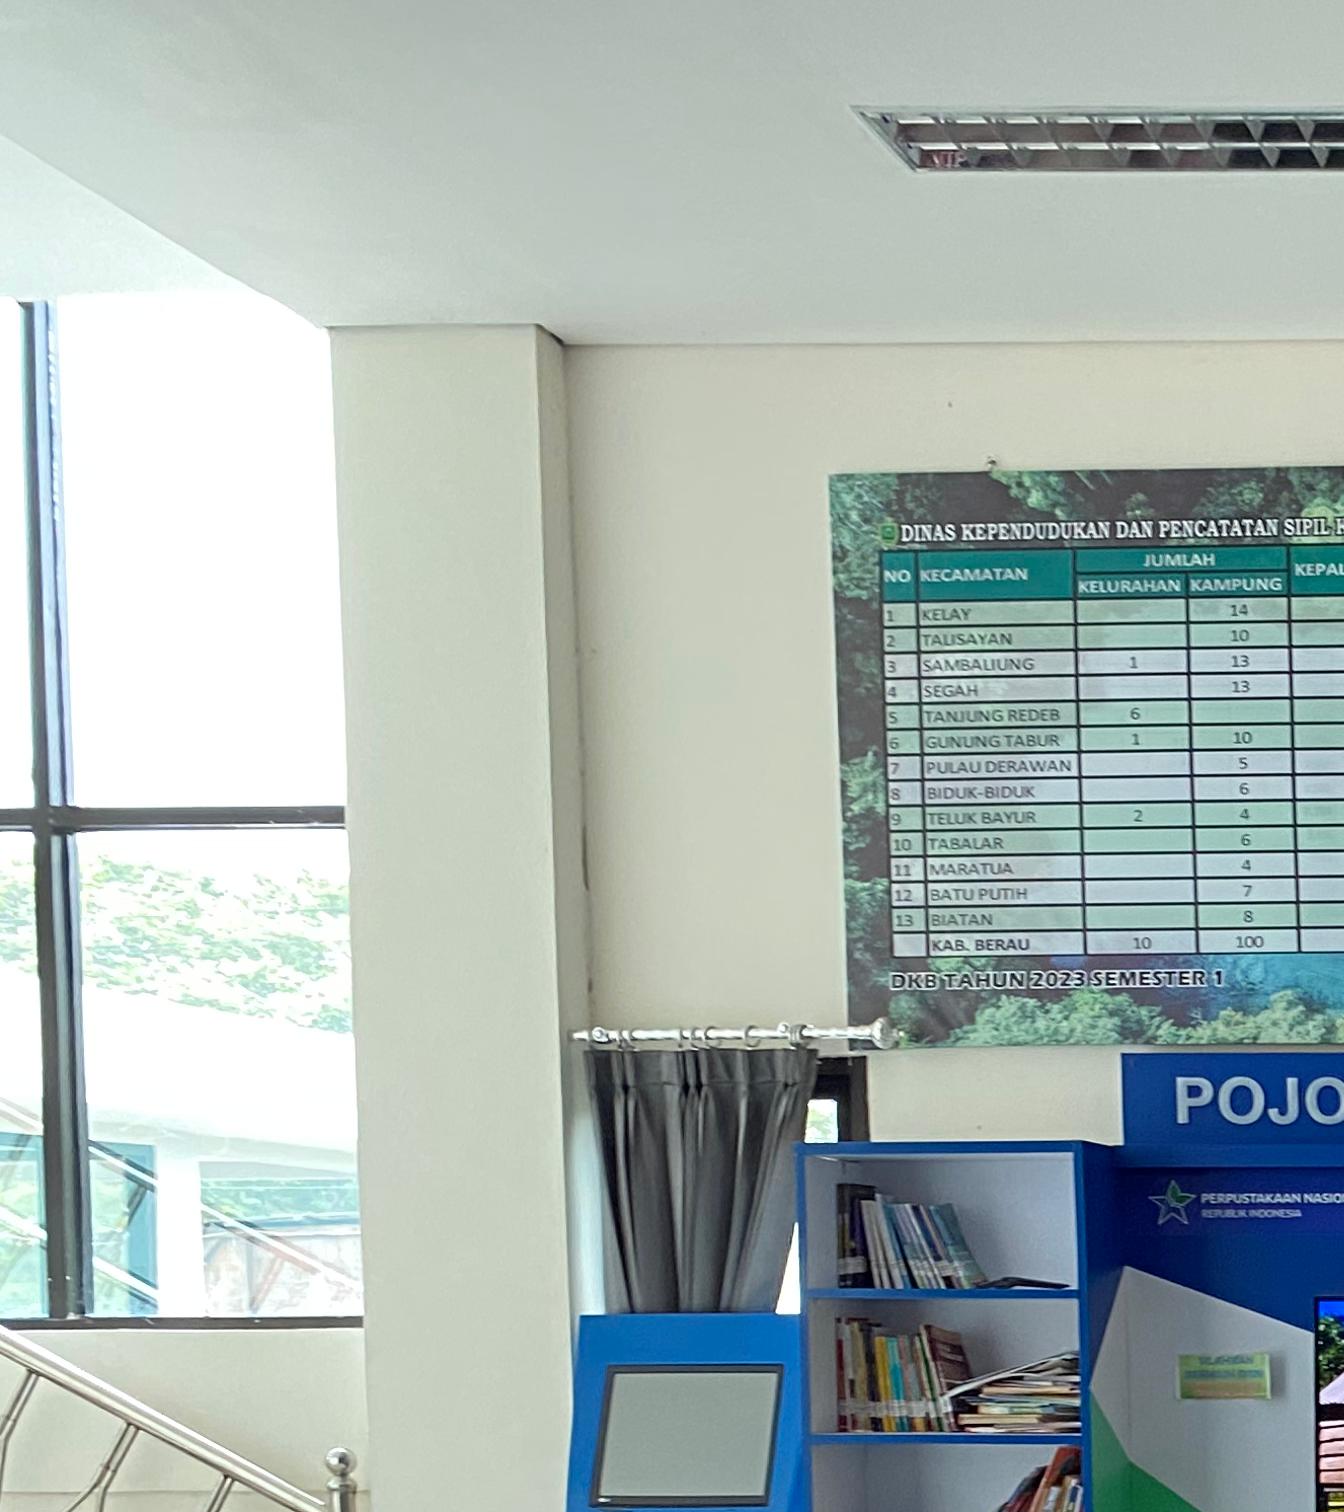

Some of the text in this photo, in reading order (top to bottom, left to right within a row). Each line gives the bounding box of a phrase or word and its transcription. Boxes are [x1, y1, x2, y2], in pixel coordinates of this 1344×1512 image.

[901, 523, 957, 542] DINAS
[961, 521, 1110, 541] KEPENDUDUKAN
[1115, 520, 1154, 538] DAN
[1158, 518, 1279, 539] PENCATATAN
[1284, 516, 1330, 536] SIPIL
[1143, 553, 1216, 568] JUMLAH
[883, 569, 912, 583] NO
[920, 567, 1029, 583] KECAMATAN
[1078, 577, 1182, 594] KELURAHAN
[1189, 577, 1283, 593] KAMPUNG
[922, 607, 972, 622] KELAY
[1230, 603, 1250, 617] 14
[922, 633, 1013, 647] TALISAYAN
[1230, 629, 1250, 642] 10
[922, 658, 1035, 673] SAMBALIUNG
[1129, 656, 1138, 671] 1
[1231, 654, 1250, 668] 13
[923, 684, 979, 698] SEGAH
[1232, 680, 1252, 693] 13
[924, 709, 1003, 723] TANJUNG
[1007, 709, 1060, 723] REDEB
[1129, 708, 1140, 722] 6
[925, 735, 1001, 749] GUNUNG
[1004, 735, 1058, 749] TABUR
[1131, 734, 1139, 748] 1
[1232, 731, 1253, 745] 10
[926, 760, 983, 774] PULAU
[985, 760, 1073, 774] DERAWAN
[1238, 756, 1249, 770] 5
[927, 785, 1036, 800] BIDUK-BIDUK
[1239, 782, 1250, 796] 6
[927, 812, 977, 826] TELUK
[981, 811, 1037, 825] BAYUR
[1133, 809, 1144, 823] 2
[1240, 807, 1251, 821] 4
[928, 837, 1004, 850] TABALAR
[1240, 833, 1252, 847] 6
[929, 862, 1014, 876] MARATUA
[1242, 859, 1253, 873] 4
[930, 888, 975, 902] BATU
[978, 887, 1028, 901] PUTIH
[1242, 884, 1253, 898] 7
[931, 913, 993, 927] BIATAN
[1243, 910, 1254, 924] 8
[931, 939, 970, 952] KAB.
[975, 938, 1030, 952] BERAU
[1132, 936, 1153, 950] 10
[1235, 935, 1265, 949] 100
[890, 967, 1224, 990] DKB TAHUN 2023 SEMESTER 1
[1200, 1193, 1301, 1204] PERPUSTAKAAN
[1248, 1208, 1303, 1218] INDONESIA
